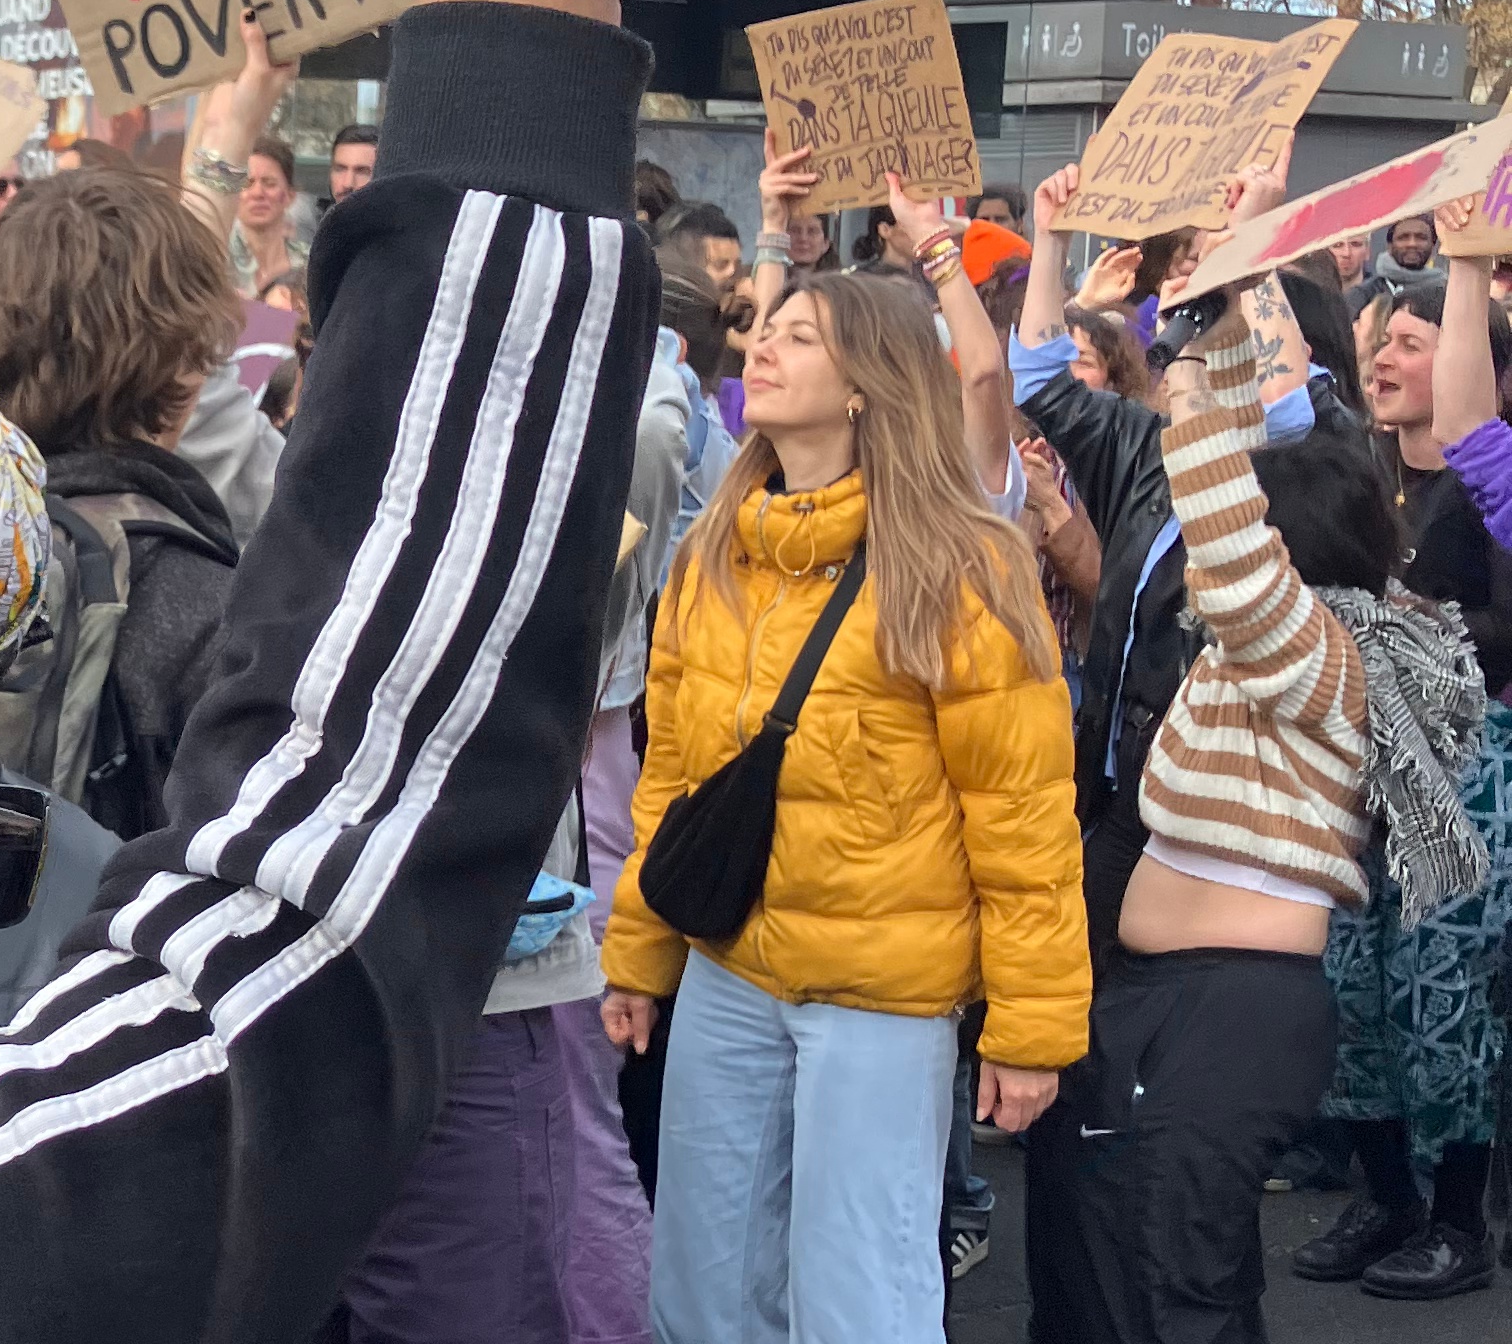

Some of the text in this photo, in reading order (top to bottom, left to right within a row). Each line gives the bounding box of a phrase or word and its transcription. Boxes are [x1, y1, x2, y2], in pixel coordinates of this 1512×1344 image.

[788, 85, 962, 152] DANS TA GUEULE
[1091, 131, 1191, 185] DANS
